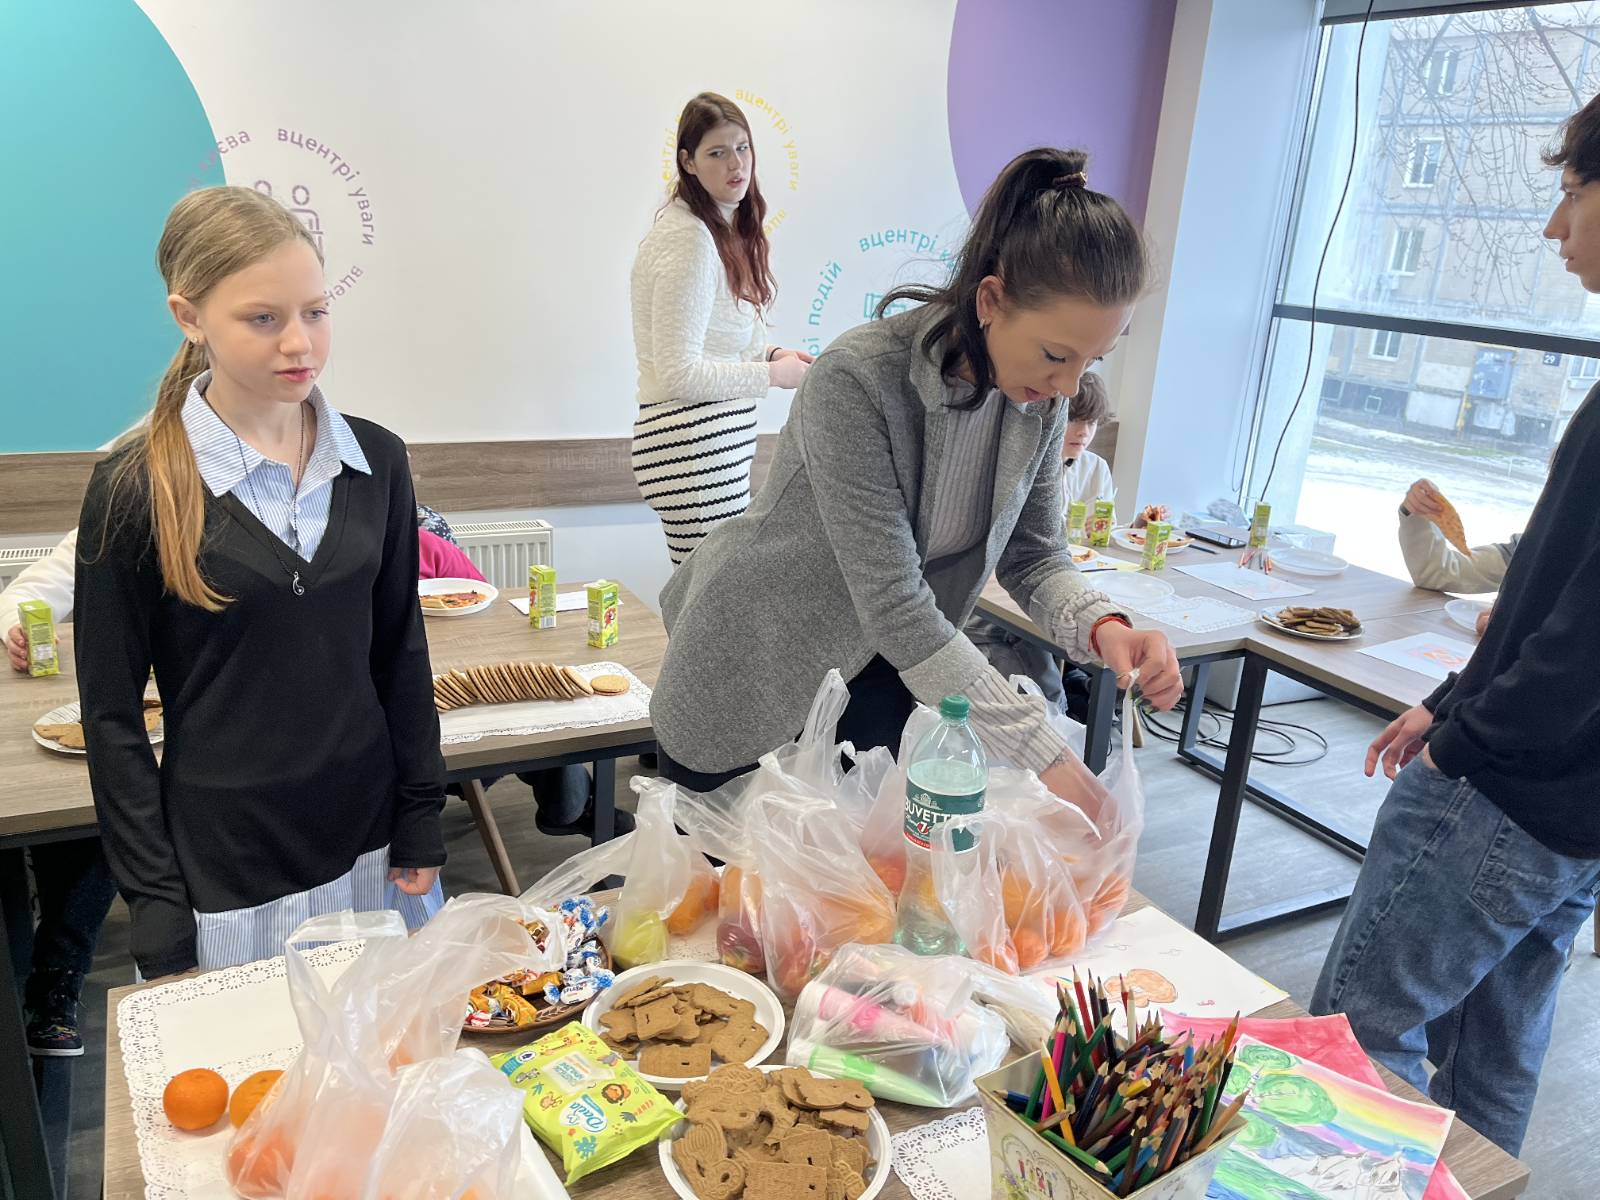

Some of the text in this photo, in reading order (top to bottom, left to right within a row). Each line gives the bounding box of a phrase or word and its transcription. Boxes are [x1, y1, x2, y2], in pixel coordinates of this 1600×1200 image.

[735, 89, 800, 191] вцентрі уваги
[277, 128, 375, 245] вцентрі уваги
[858, 229, 939, 253] вцентрі
[808, 259, 844, 326] подій
[1544, 355, 1555, 364] 29
[905, 797, 951, 823] BUVETT
